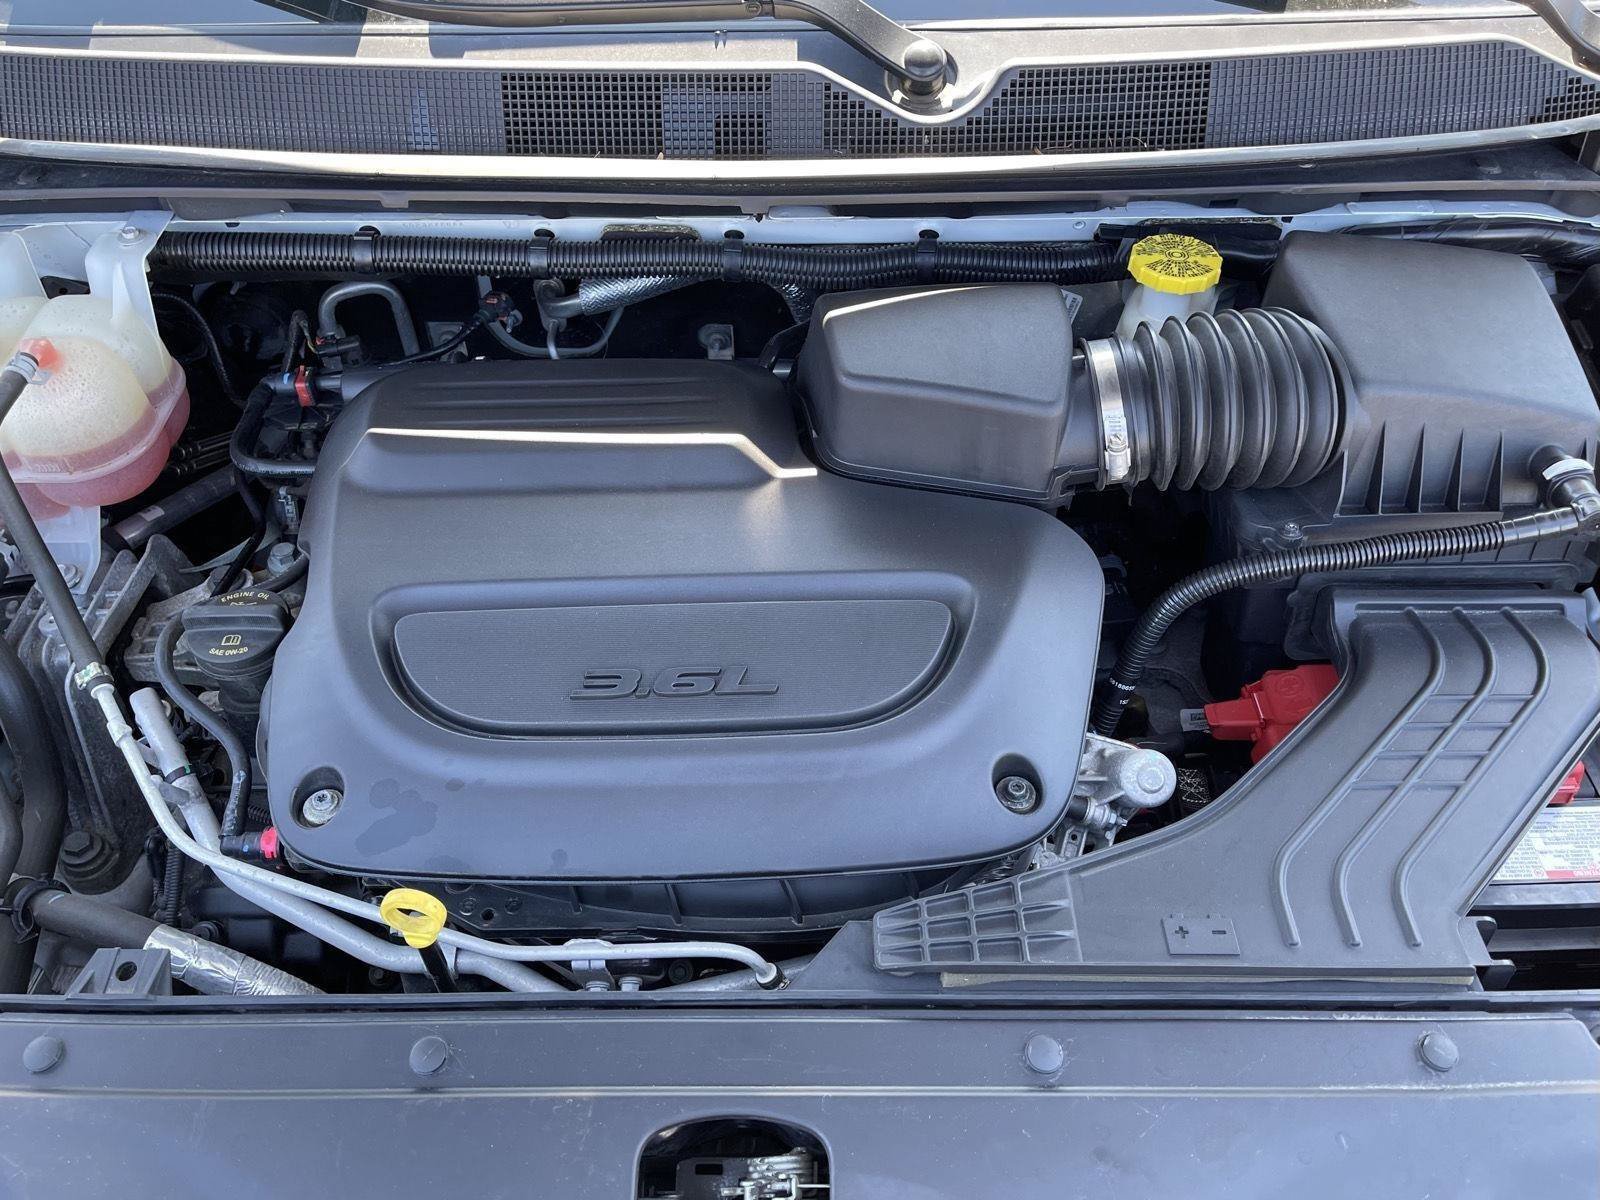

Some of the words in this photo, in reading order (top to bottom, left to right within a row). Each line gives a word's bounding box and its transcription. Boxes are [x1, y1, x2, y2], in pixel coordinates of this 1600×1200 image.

[221, 591, 255, 602] ENGINE
[257, 592, 270, 600] OIL
[209, 647, 224, 656] SAE
[225, 646, 249, 656] 0W-20
[569, 665, 780, 701] 3.6L
